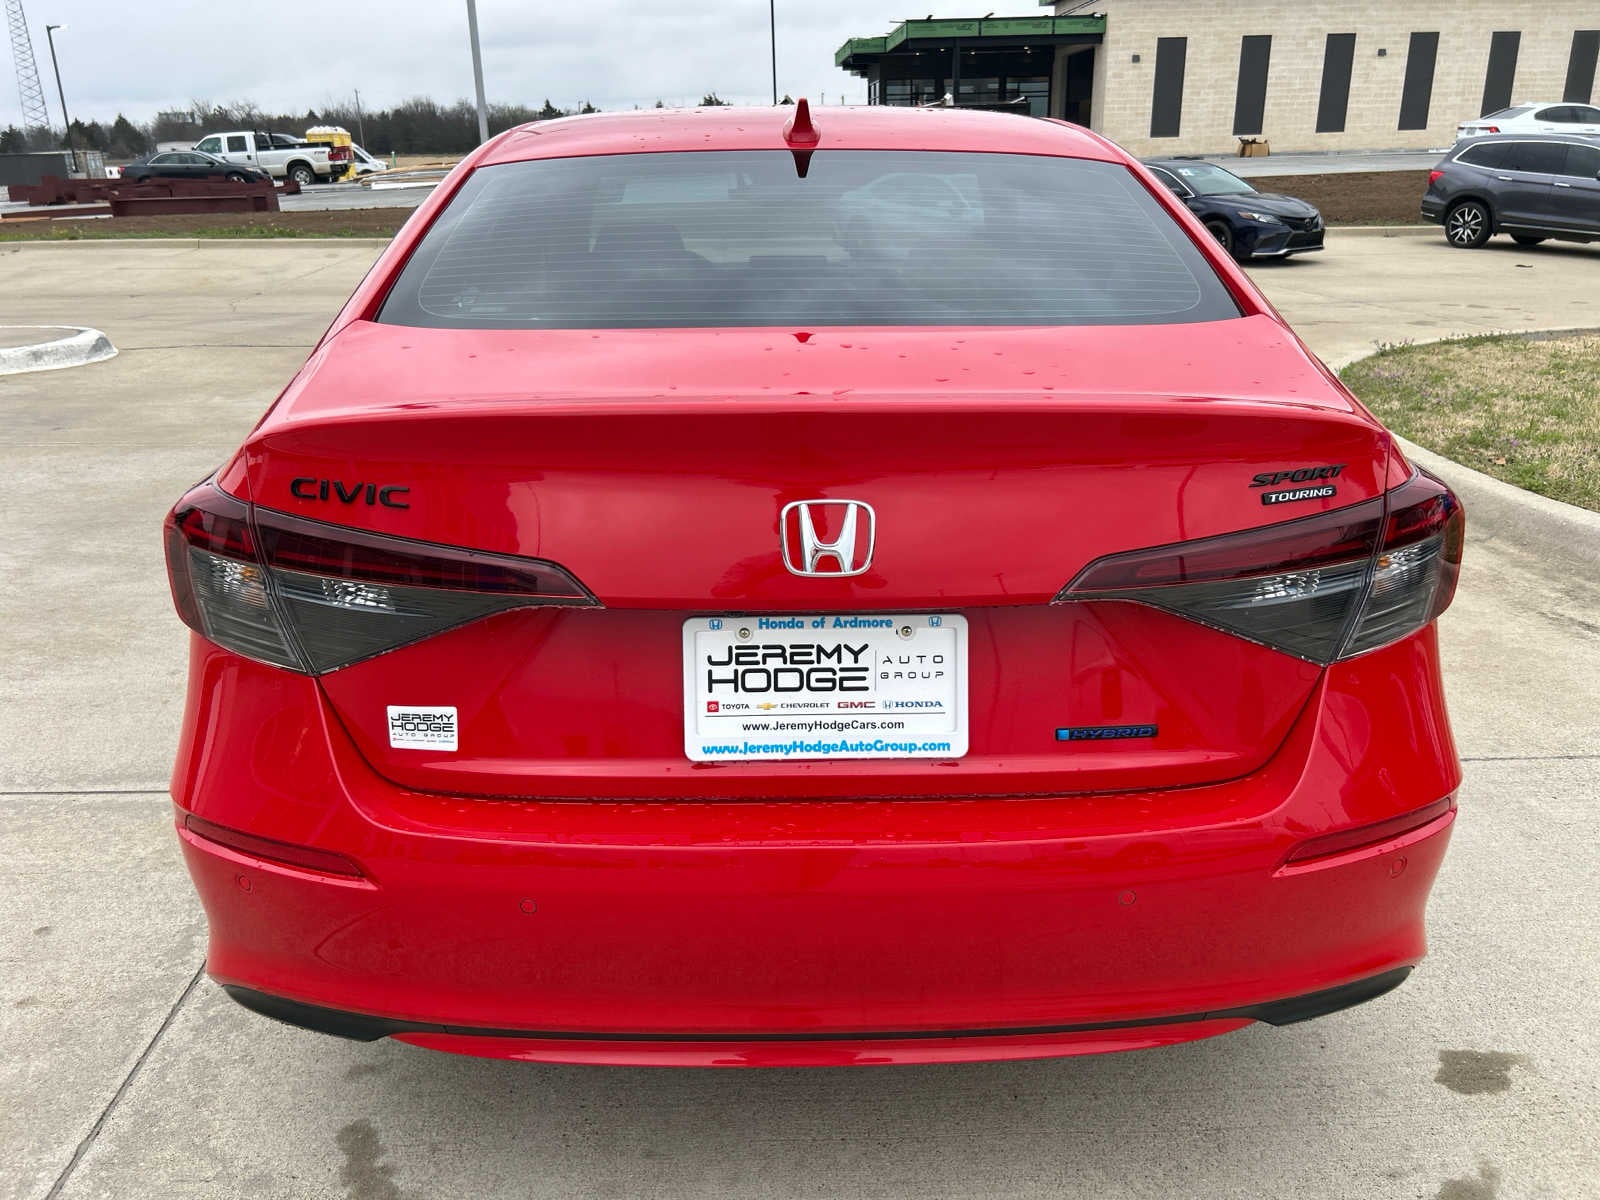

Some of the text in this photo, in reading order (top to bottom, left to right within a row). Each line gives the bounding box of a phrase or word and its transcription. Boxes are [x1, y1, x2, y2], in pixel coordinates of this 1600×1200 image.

[1248, 464, 1348, 488] SPORT
[290, 476, 410, 509] CIVIC
[1269, 487, 1333, 503] TOURING
[758, 617, 893, 630] Honda of Ardmore
[707, 643, 869, 666] JEREMY
[882, 655, 944, 665] AUTO
[707, 667, 870, 693] HODGE
[880, 671, 944, 680] GROUP
[780, 701, 830, 709] CHEVROLET
[837, 701, 876, 709] GMC
[895, 700, 943, 708] HONDA
[391, 713, 453, 722] JEREMY
[391, 722, 454, 732] HODGE
[742, 719, 905, 734] www.JeremyHodgeCars.com
[1071, 727, 1154, 739] HYBRID
[702, 739, 951, 756] www.JeremyHodgeAutoGroup.com
